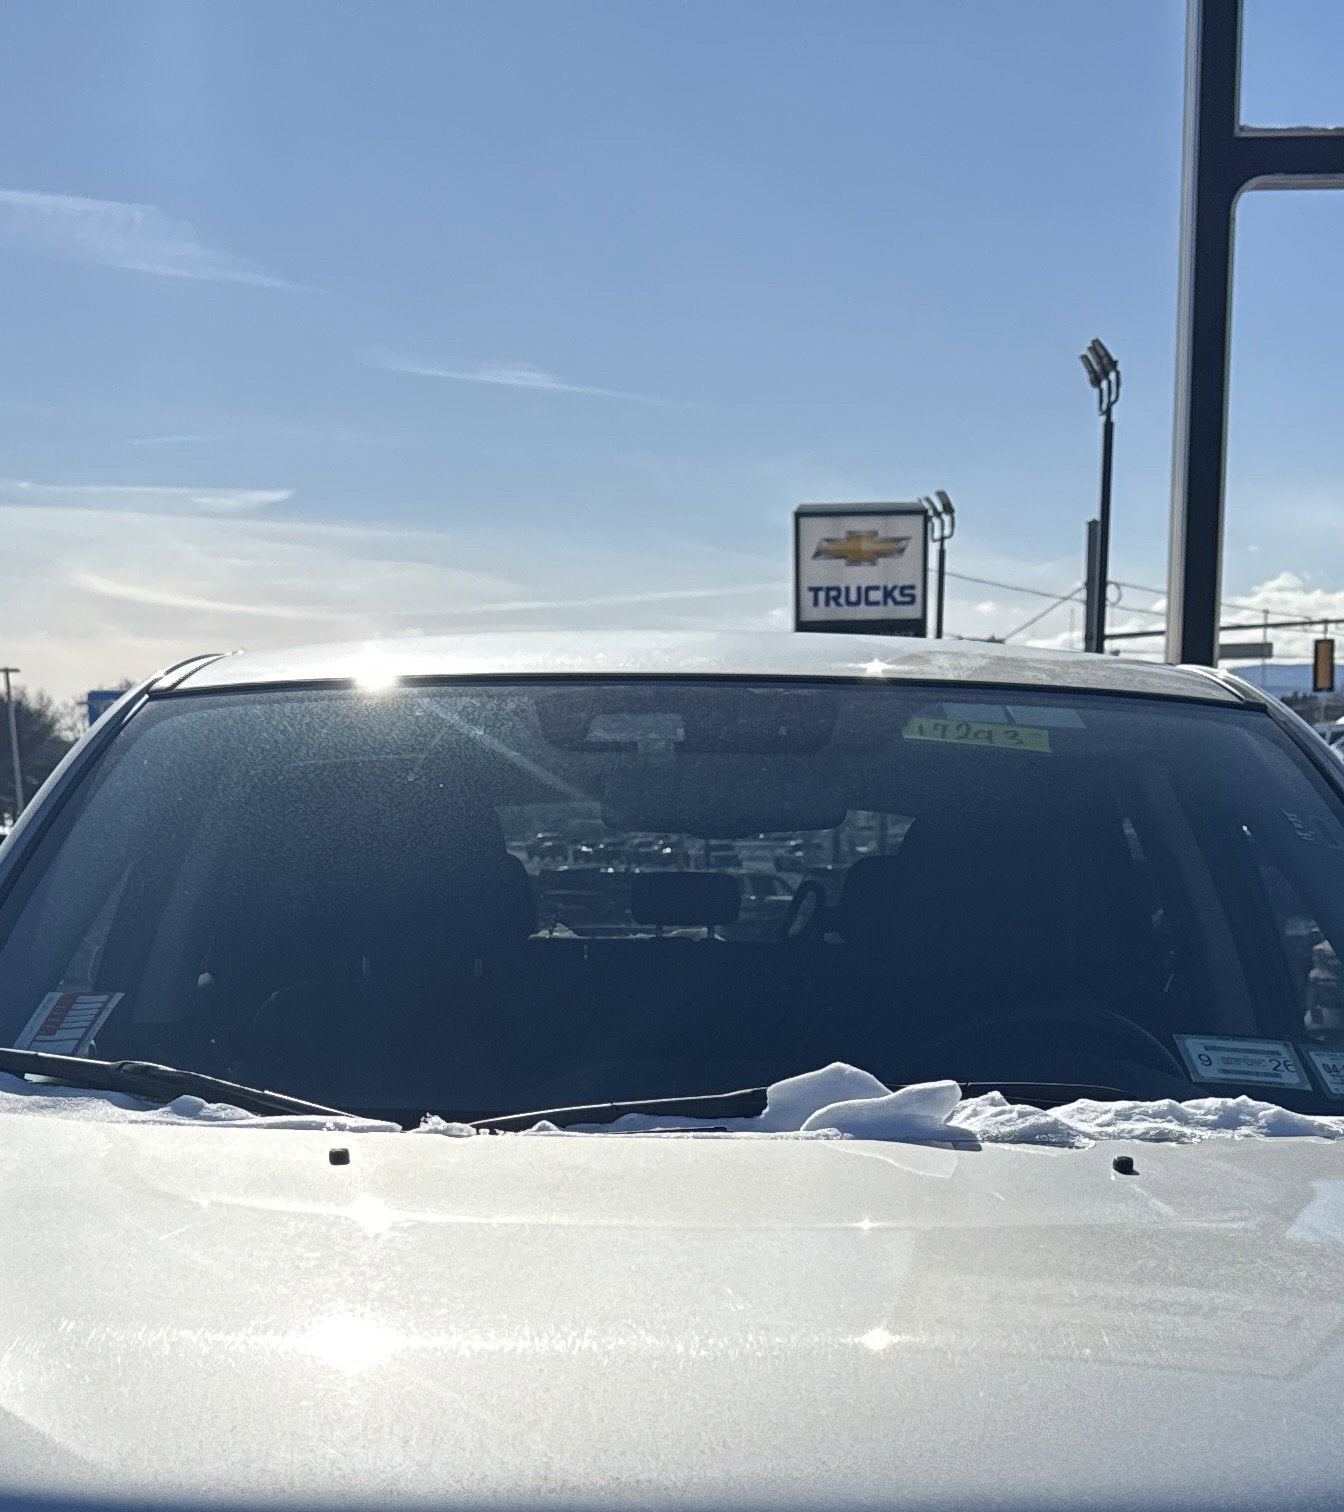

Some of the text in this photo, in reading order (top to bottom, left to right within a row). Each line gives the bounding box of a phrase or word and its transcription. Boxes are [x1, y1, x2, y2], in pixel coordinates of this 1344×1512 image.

[808, 584, 917, 607] TRUCKS
[1198, 1054, 1213, 1067] 9
[1268, 1058, 1298, 1074] 26
